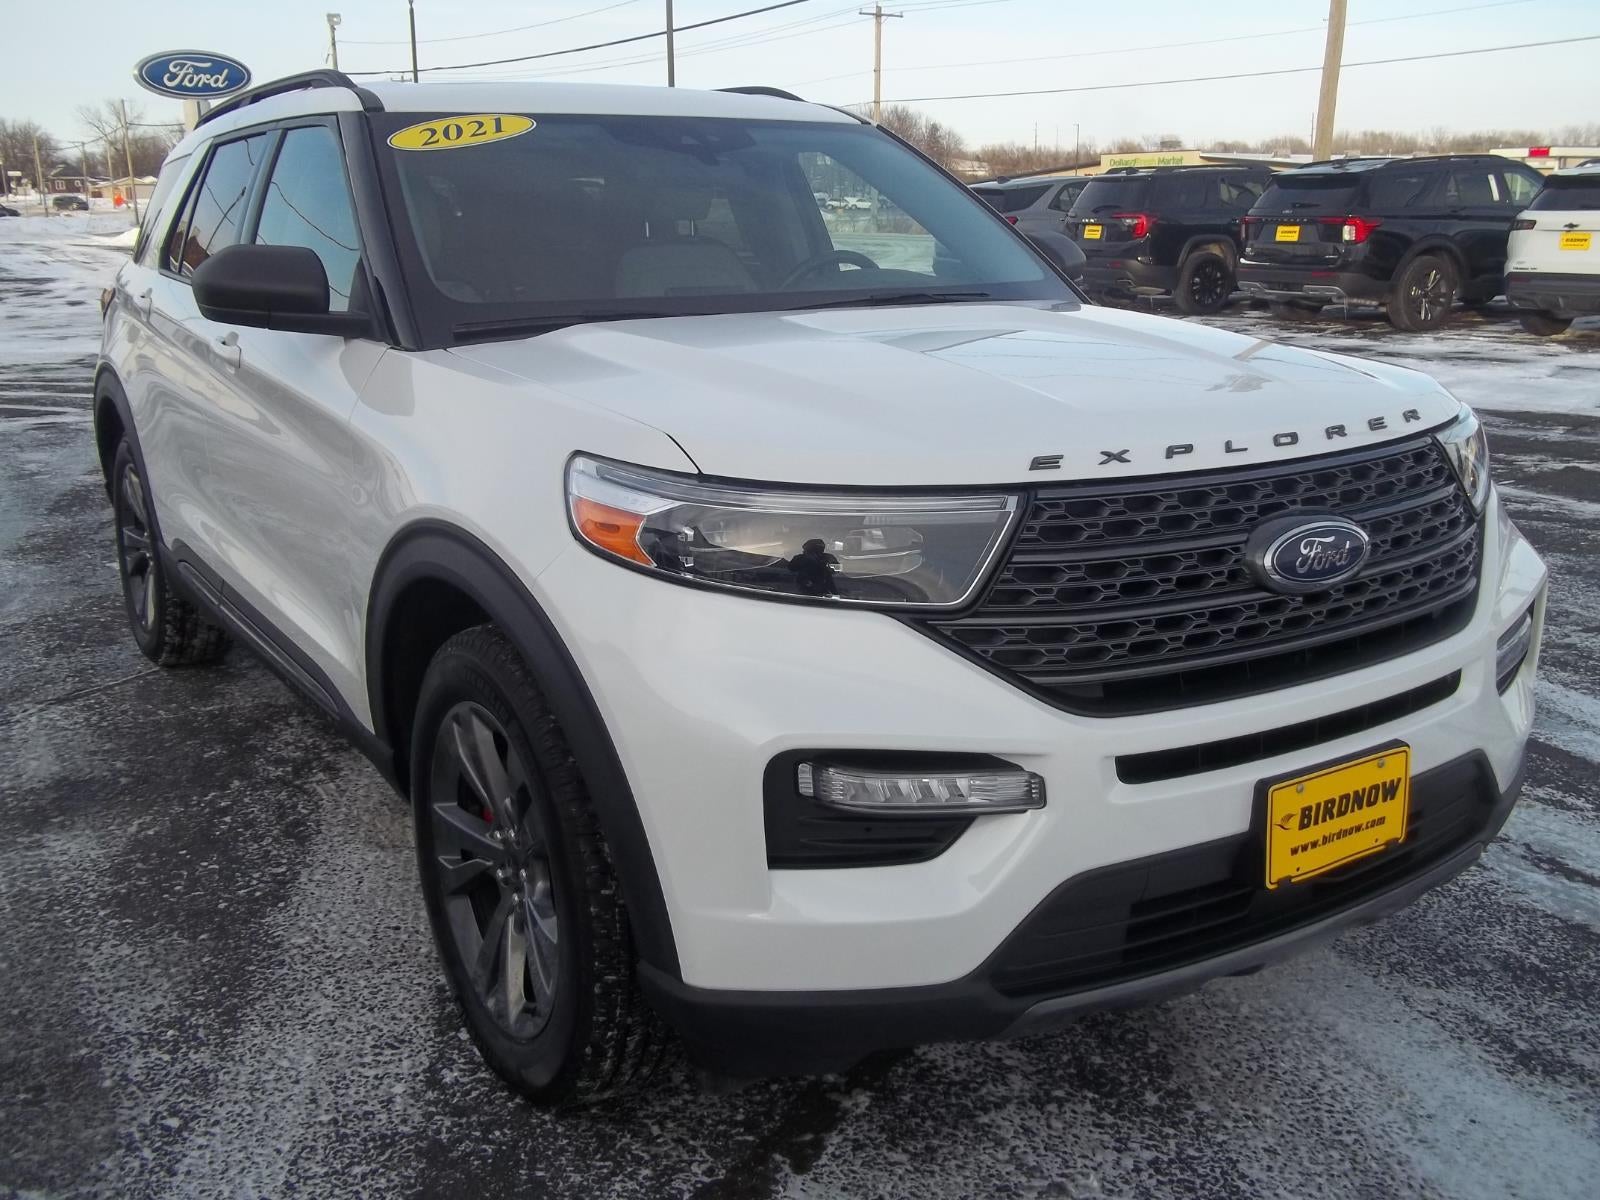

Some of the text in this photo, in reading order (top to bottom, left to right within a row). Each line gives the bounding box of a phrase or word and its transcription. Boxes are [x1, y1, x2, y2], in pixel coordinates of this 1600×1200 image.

[163, 60, 228, 87] Ford
[419, 117, 504, 147] 2021
[1028, 408, 1422, 471] EXPLORER
[1296, 536, 1350, 573] Ford
[1298, 777, 1402, 831] BIRDNOW
[1290, 816, 1386, 856] www.birdnow.com
